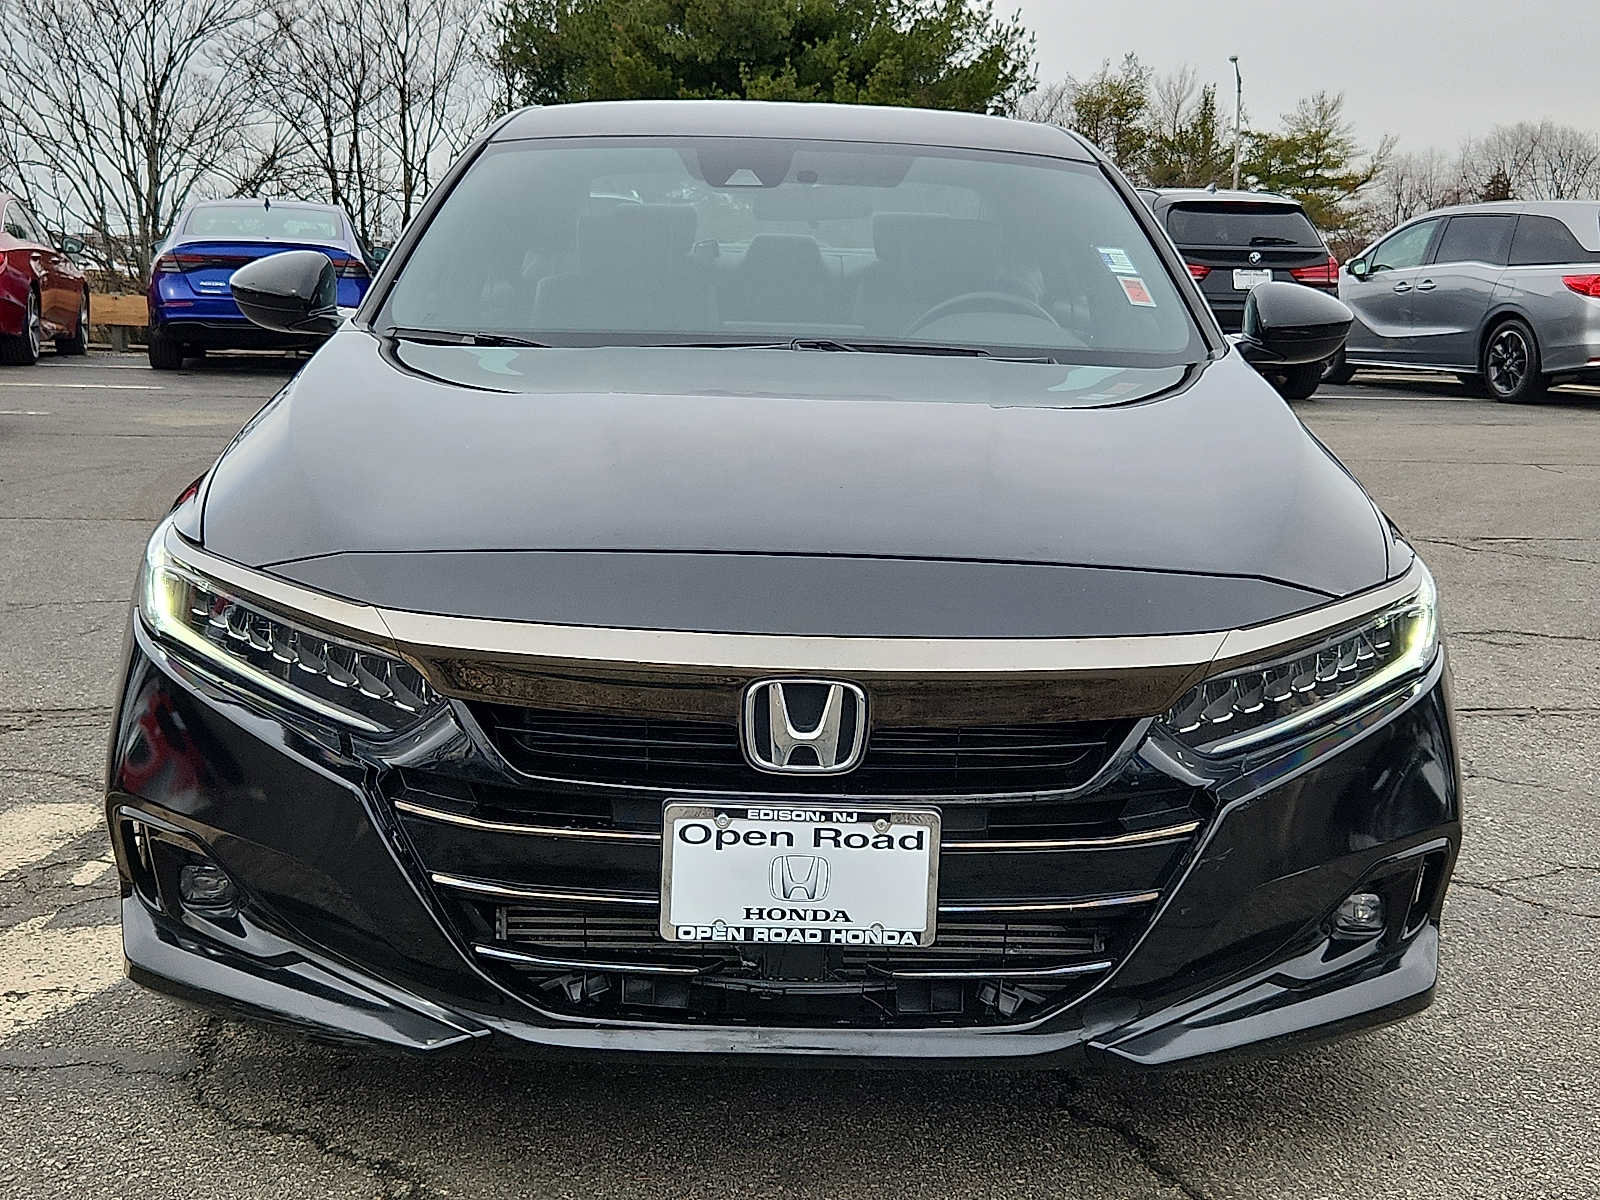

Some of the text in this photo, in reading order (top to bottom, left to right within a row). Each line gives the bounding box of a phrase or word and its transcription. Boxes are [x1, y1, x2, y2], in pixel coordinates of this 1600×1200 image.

[747, 809, 858, 823] EDISON, NJ
[678, 823, 924, 851] Open Road
[743, 907, 853, 923] HONDA
[677, 926, 918, 945] OPEN ROAD HONDA
